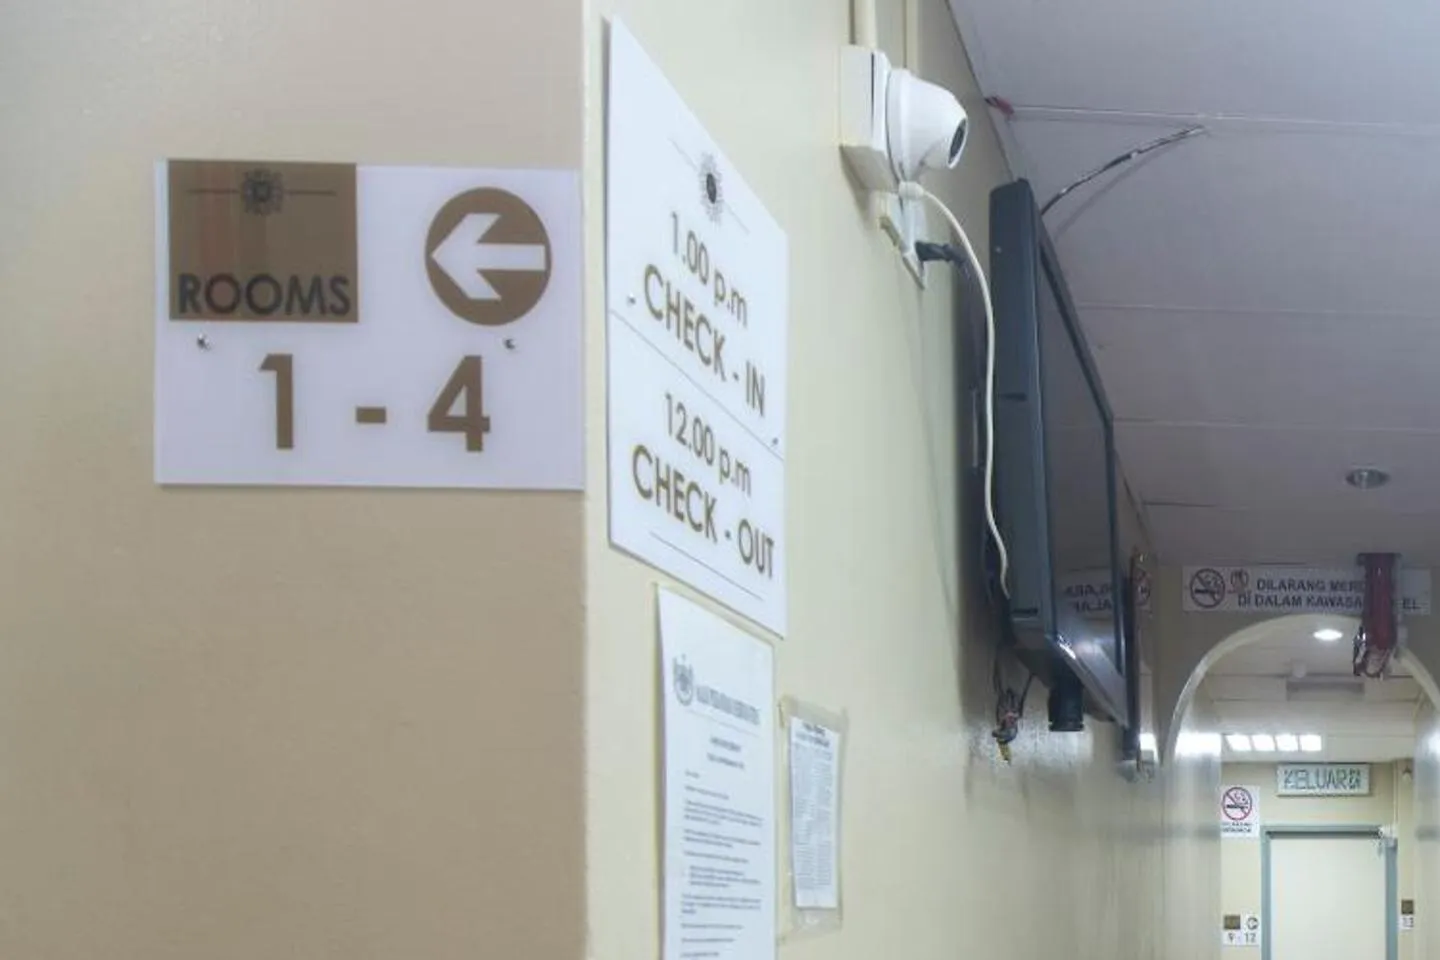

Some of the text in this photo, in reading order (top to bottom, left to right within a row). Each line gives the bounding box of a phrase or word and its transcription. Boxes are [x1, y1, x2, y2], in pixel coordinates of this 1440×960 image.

[177, 272, 352, 318] ROOMS
[671, 211, 748, 329] 1.00 p.m
[644, 263, 727, 384] CHECK
[745, 359, 766, 418] IN
[259, 352, 294, 450] 1
[427, 354, 491, 453] 4
[665, 391, 752, 498] 12.00 p.m
[632, 443, 718, 544] CHECK
[738, 518, 774, 579] OUT
[1254, 593, 1302, 608] DALAM
[1306, 594, 1364, 608] KAWASA
[1257, 577, 1326, 592] DILARANG
